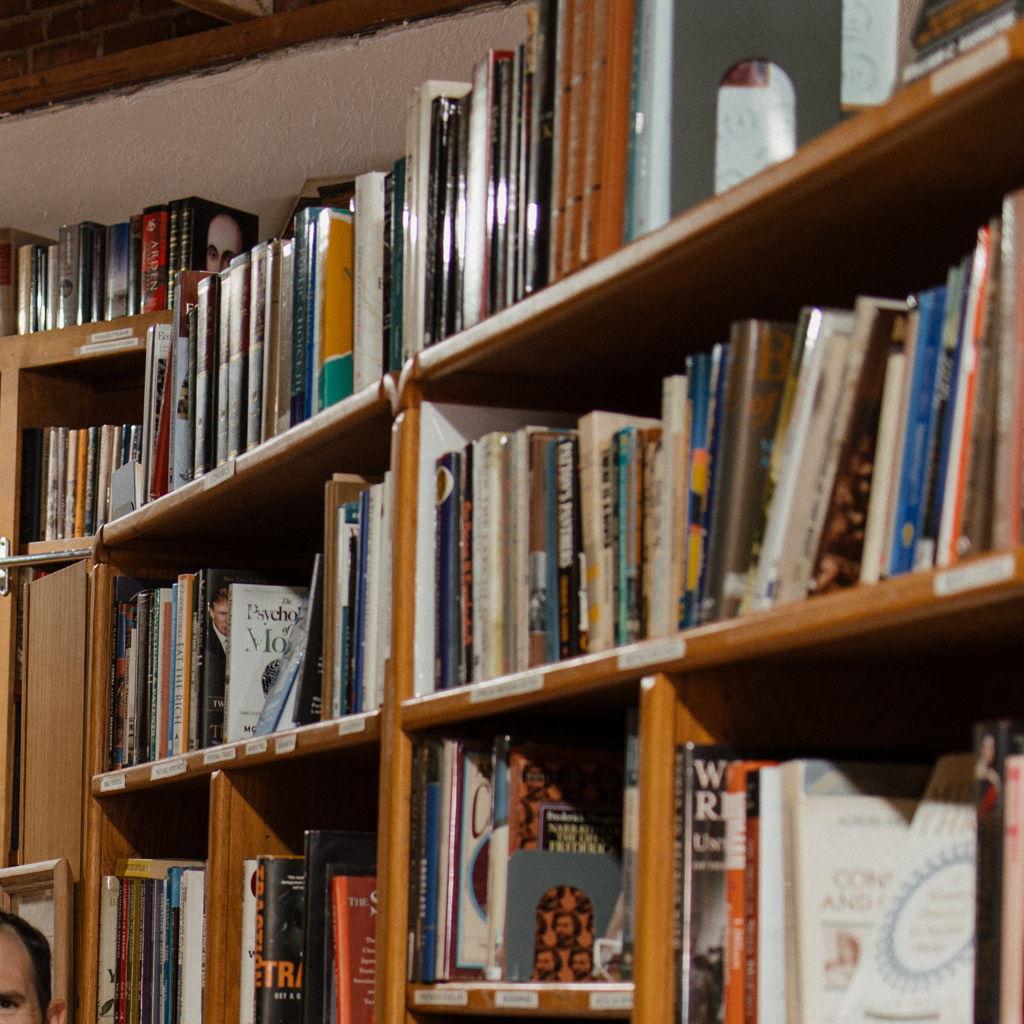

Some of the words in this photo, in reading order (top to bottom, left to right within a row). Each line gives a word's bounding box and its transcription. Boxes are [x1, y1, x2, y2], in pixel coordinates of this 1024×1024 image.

[148, 241, 158, 291] ARDEN
[295, 308, 304, 367] CHOICE
[282, 597, 292, 605] The
[282, 624, 291, 635] of
[274, 992, 287, 1000] GET
